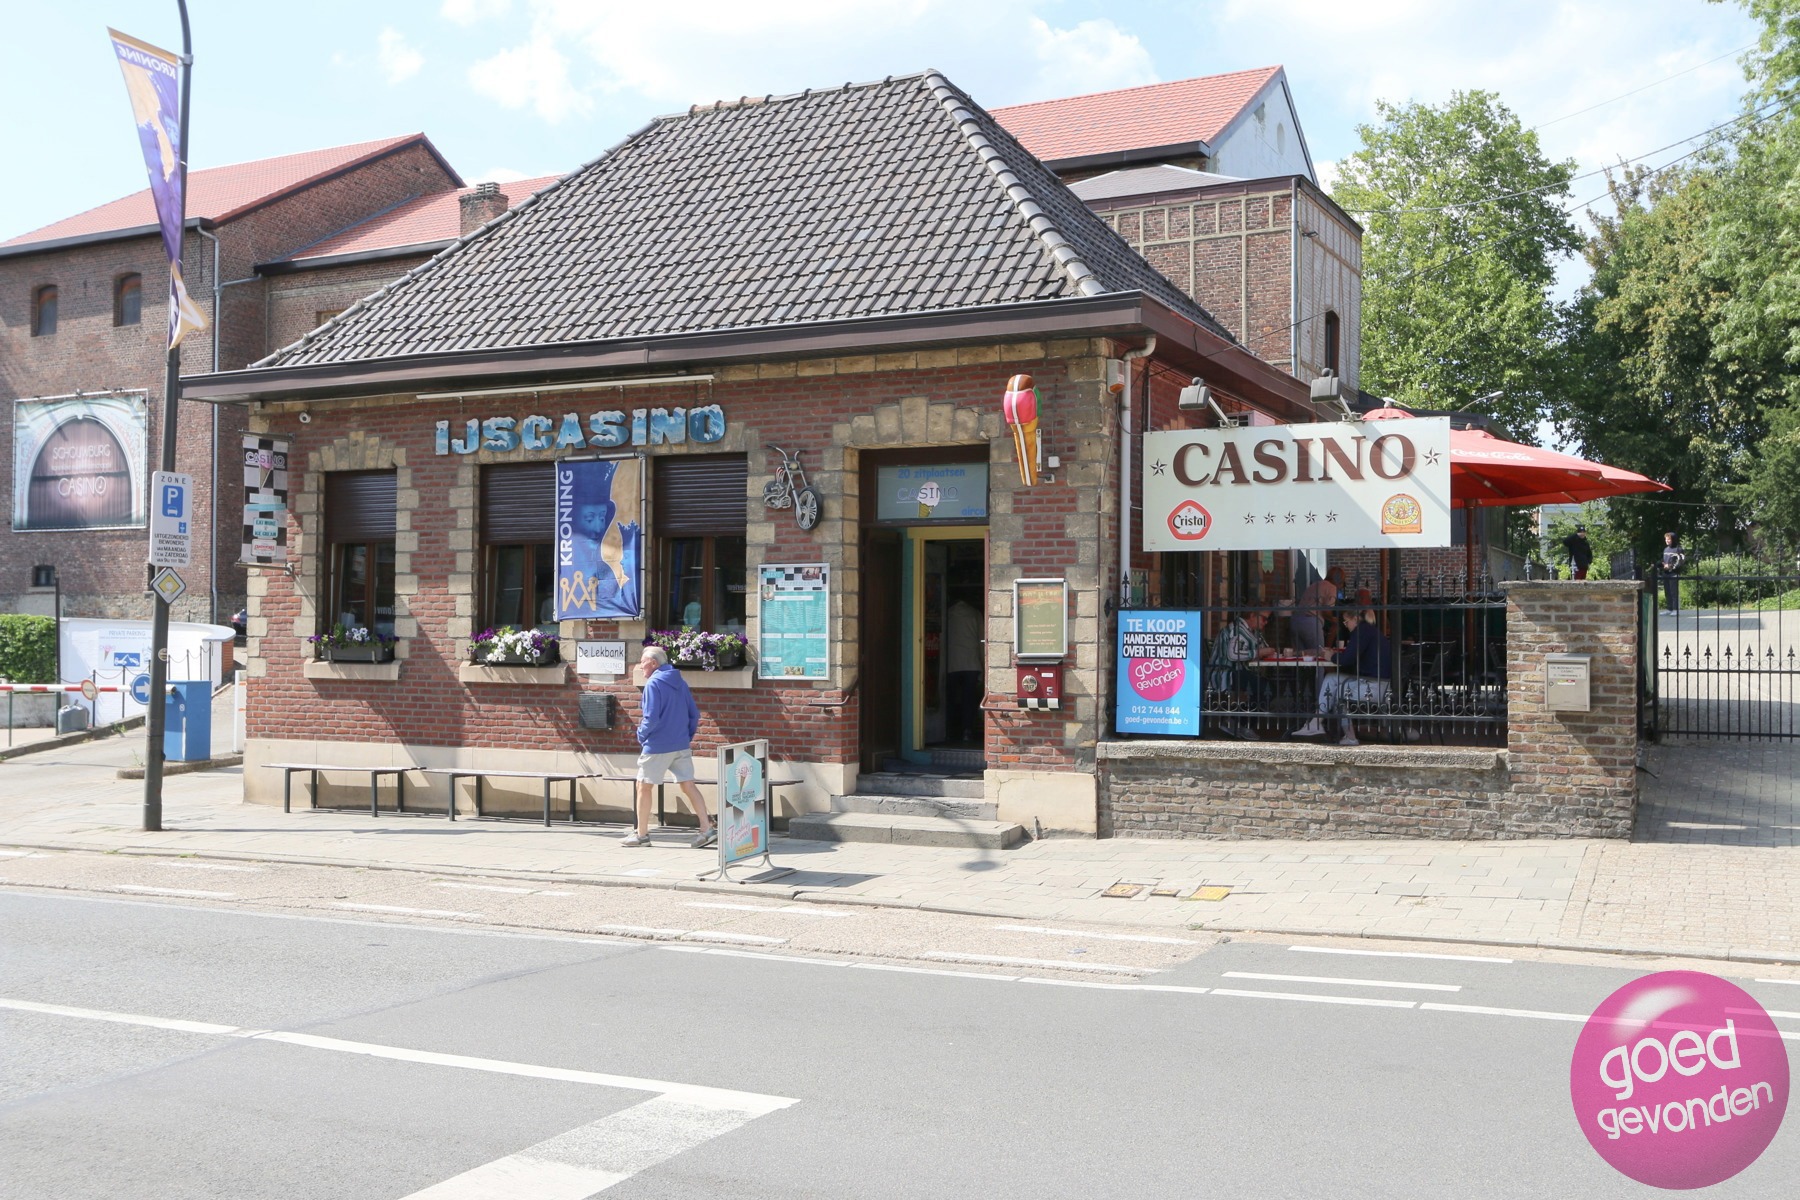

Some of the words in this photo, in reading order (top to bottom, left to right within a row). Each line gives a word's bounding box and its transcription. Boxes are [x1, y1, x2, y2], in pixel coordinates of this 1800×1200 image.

[53, 444, 111, 459] SCHOUWBURG
[245, 451, 286, 467] CASINO
[1172, 433, 1416, 487] CASINO
[161, 476, 186, 484] ZONE
[898, 469, 910, 479] 20
[914, 468, 965, 480] zitplaatsen
[58, 476, 106, 497] CASINO
[897, 486, 959, 500] CASINO
[167, 487, 178, 505] P
[961, 506, 985, 516] airco
[559, 470, 573, 566] KRONING
[1172, 514, 1206, 529] Cristal
[1127, 619, 1143, 632] TE
[1147, 619, 1186, 632] KOOP
[1123, 634, 1187, 645] HANDELSFONDS
[578, 646, 589, 658] De
[590, 646, 624, 658] Lekbank
[1123, 645, 1145, 657] OVER
[1145, 646, 1155, 658] TE
[1156, 646, 1187, 658] NEMEN
[1136, 667, 1181, 690] gevonden
[1046, 686, 1054, 696] 5
[1132, 705, 1147, 714] 012
[1149, 706, 1163, 714] 744
[1165, 706, 1180, 715] 844
[1125, 716, 1182, 725] goed-gevonden.be
